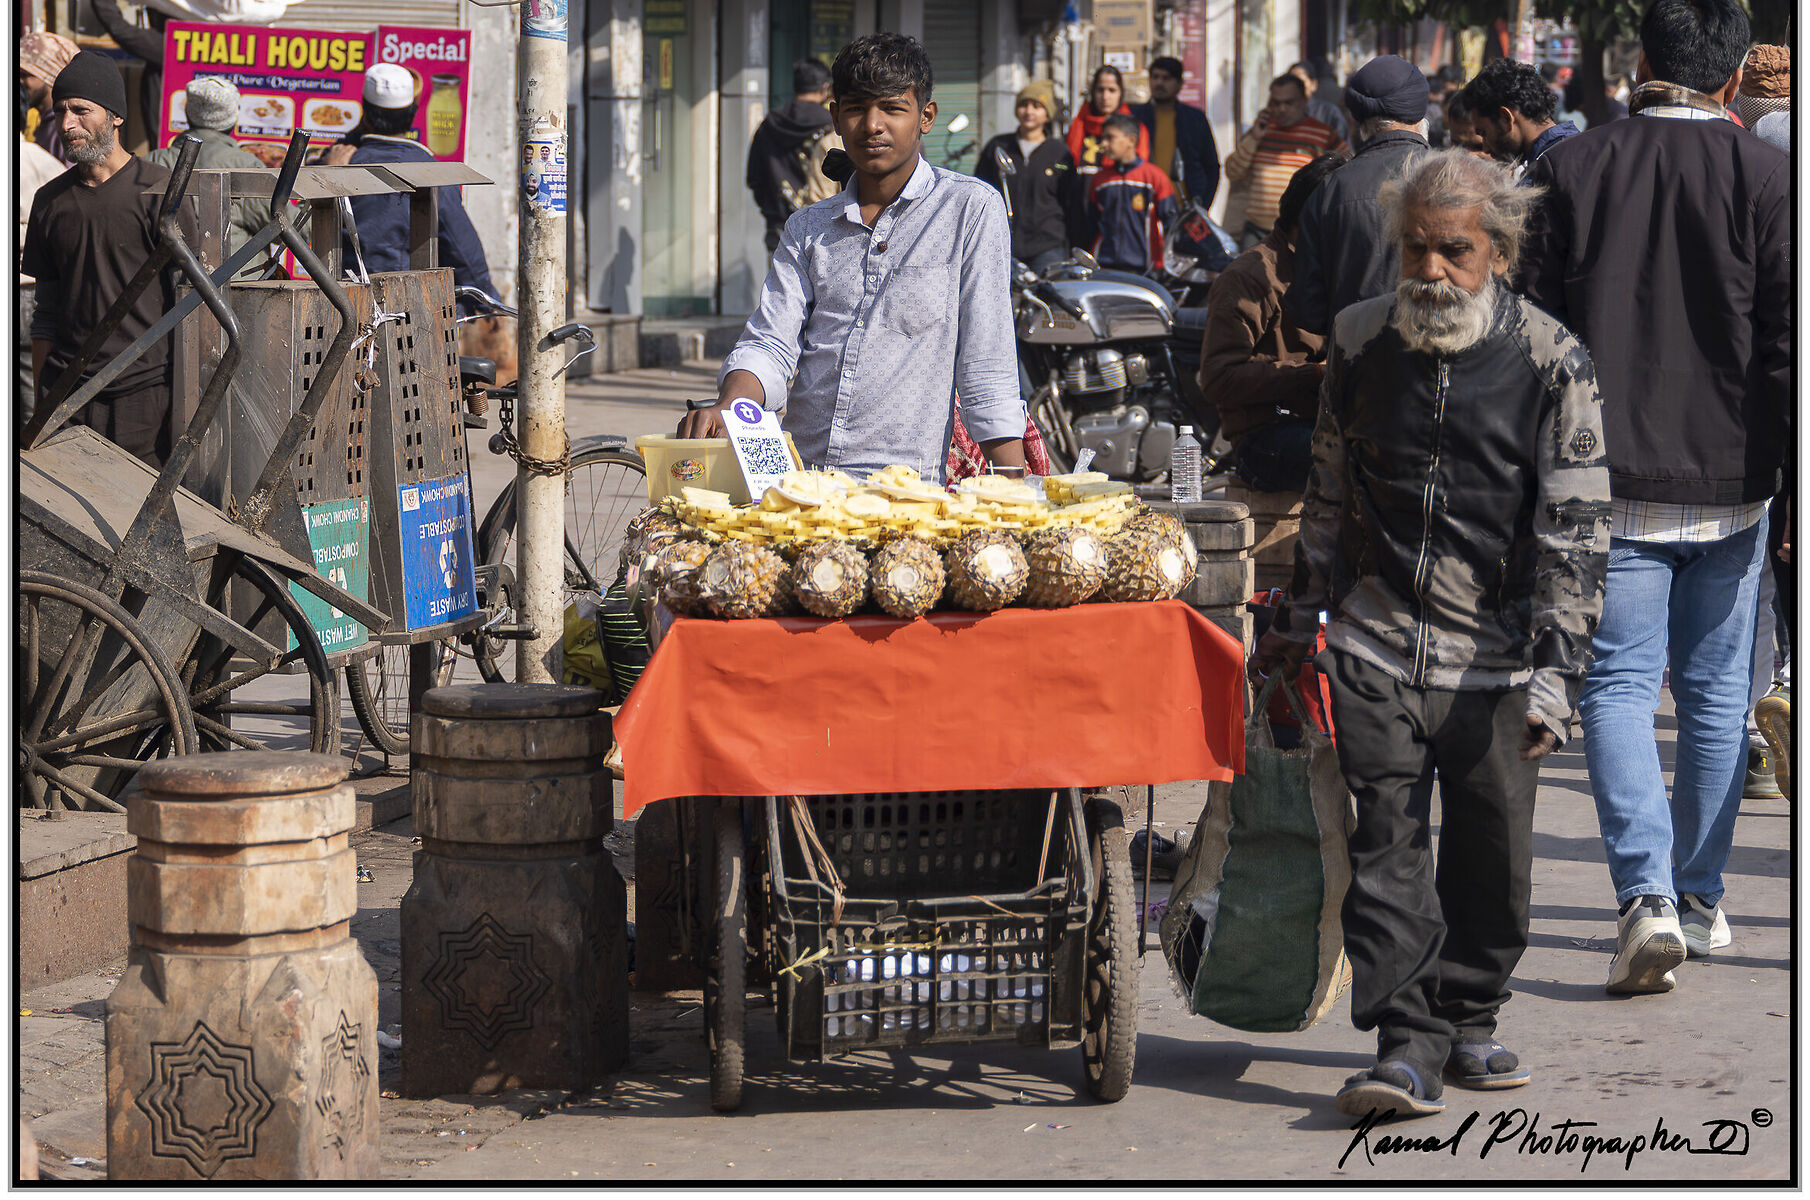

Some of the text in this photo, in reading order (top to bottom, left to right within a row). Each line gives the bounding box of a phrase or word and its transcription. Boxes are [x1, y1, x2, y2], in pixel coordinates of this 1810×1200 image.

[173, 30, 366, 72] THALI HOUSE
[382, 34, 467, 62] Special
[266, 76, 340, 91] Vegetarian
[420, 489, 444, 504] CHOWK
[311, 513, 332, 528] CHOWK
[313, 542, 359, 564] COMPOSTABL
[430, 597, 456, 617] WASTE
[344, 622, 359, 642] WET
